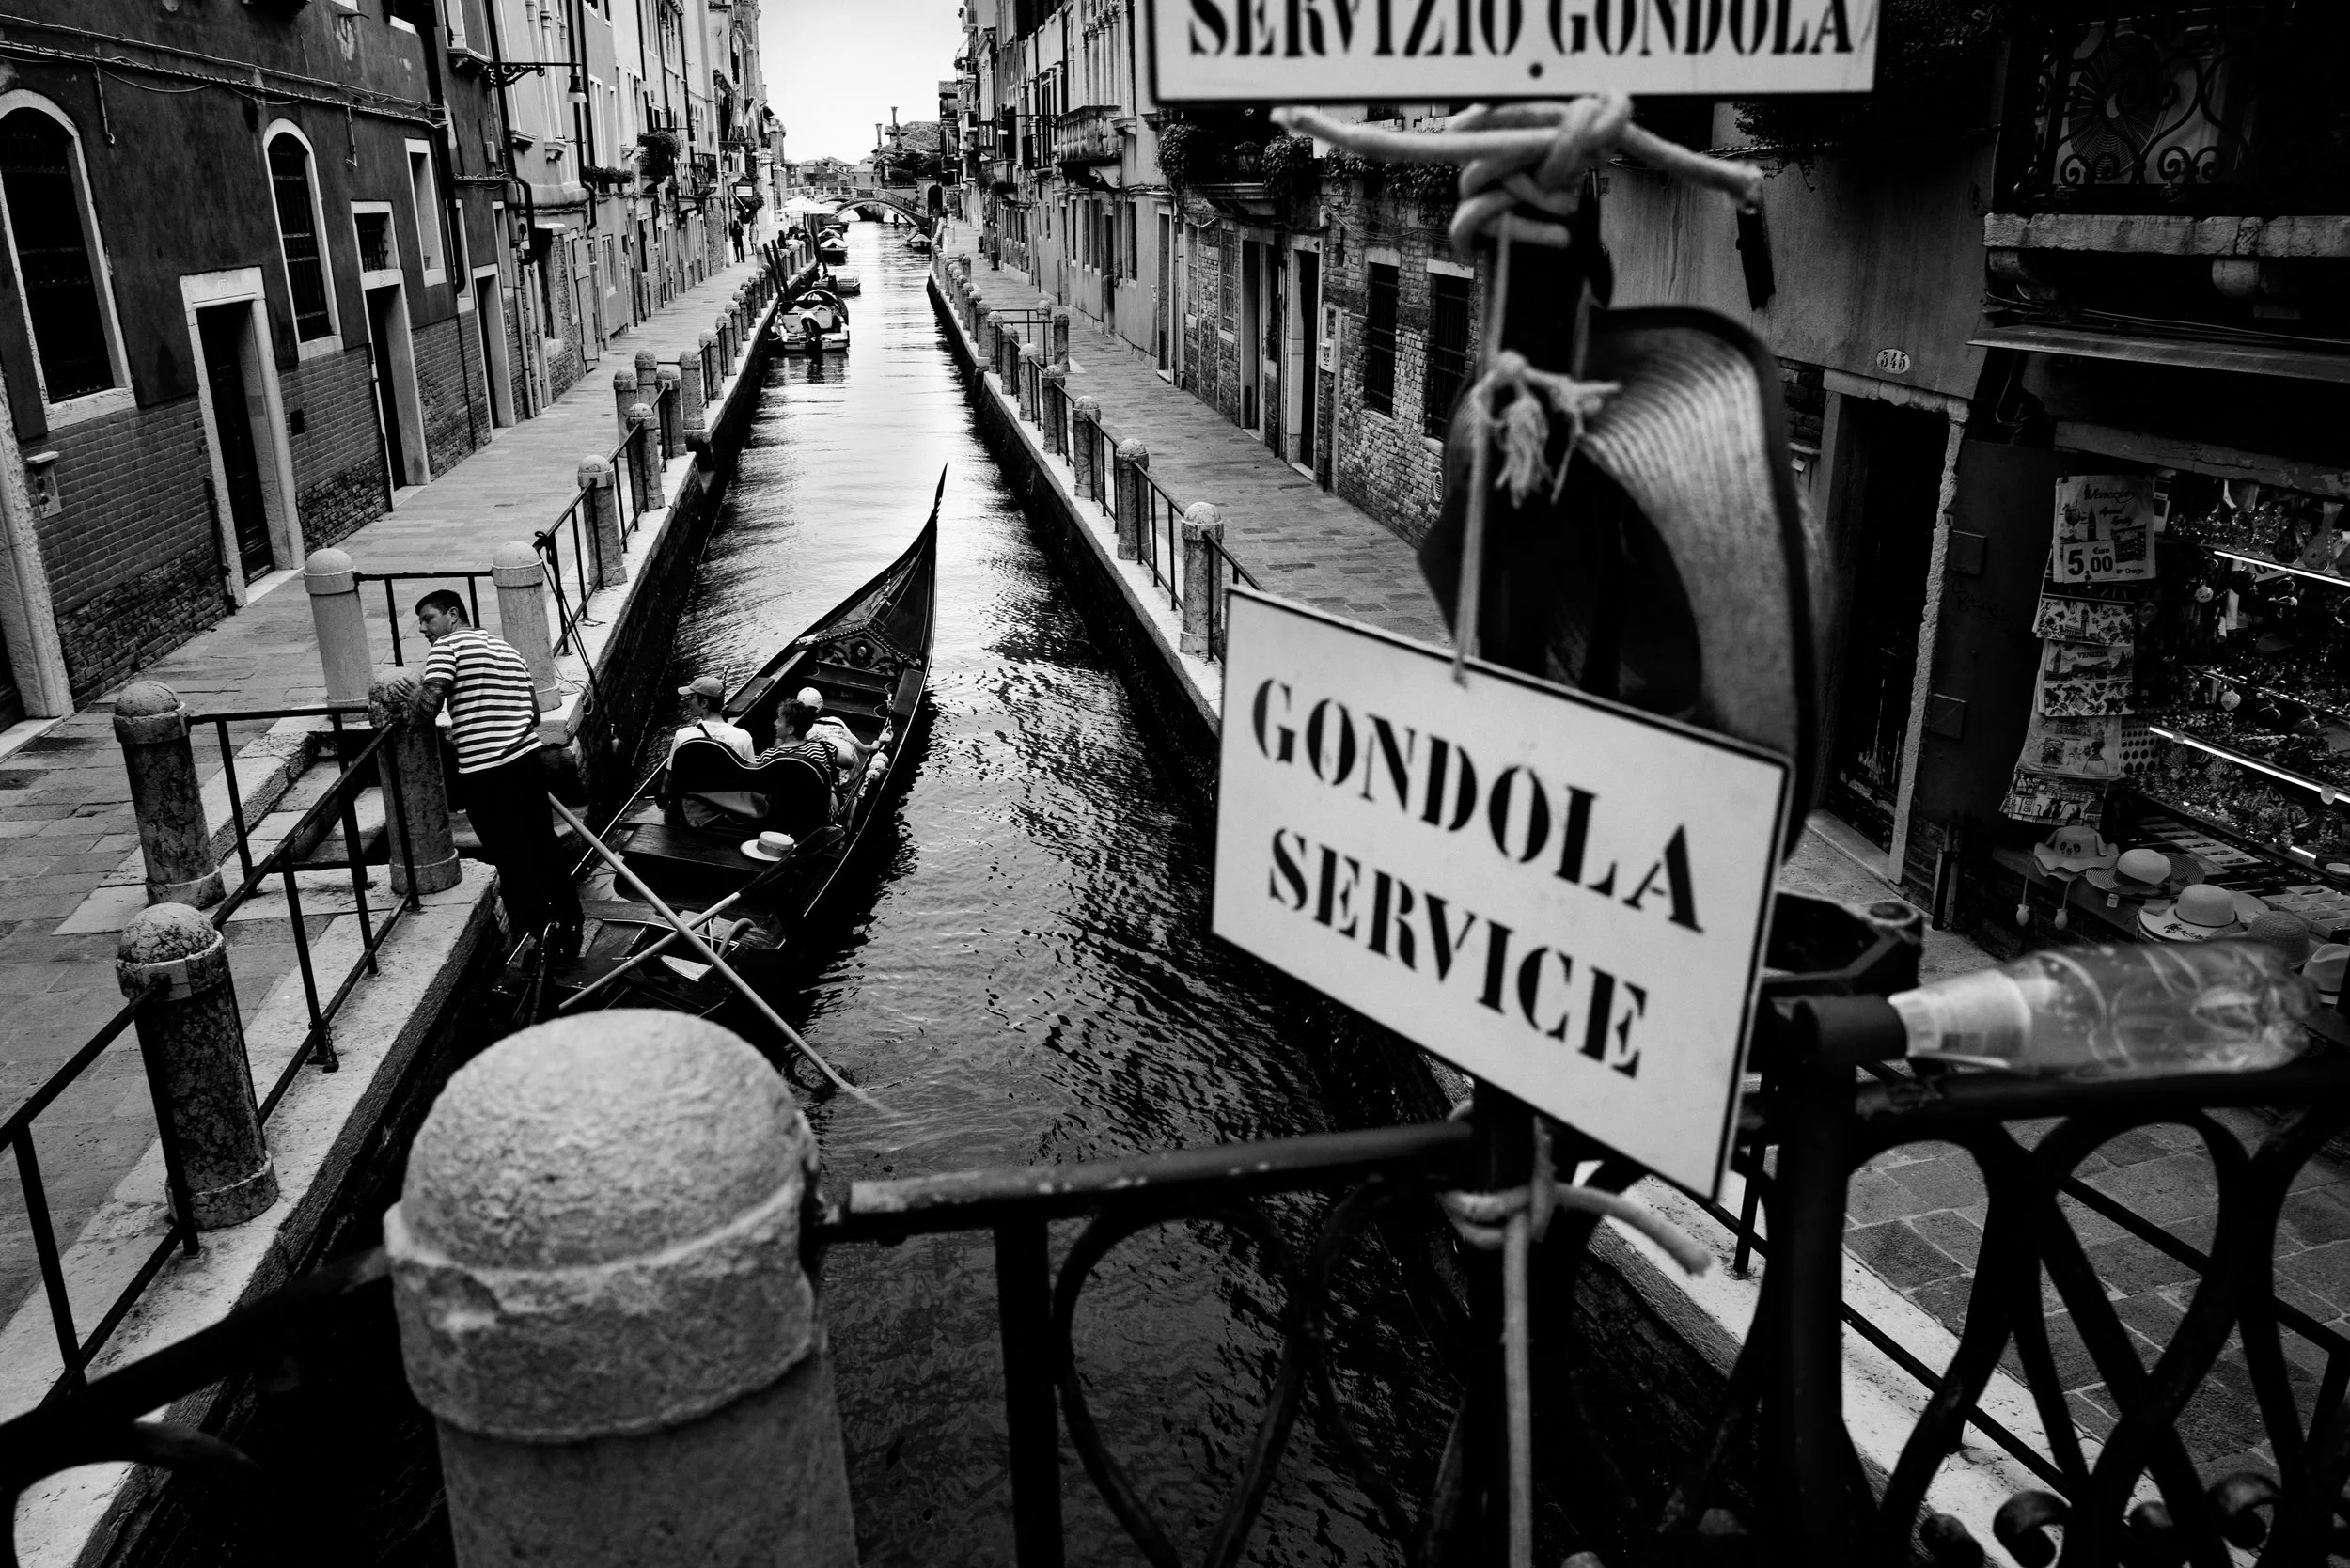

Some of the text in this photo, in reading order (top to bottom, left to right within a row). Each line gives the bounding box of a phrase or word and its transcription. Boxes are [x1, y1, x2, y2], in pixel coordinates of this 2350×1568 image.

[1188, 0, 1854, 57] SERVIZIO GONDOLA
[1251, 677, 1706, 935] GONDOLA
[1268, 826, 1649, 1079] SERVICE
